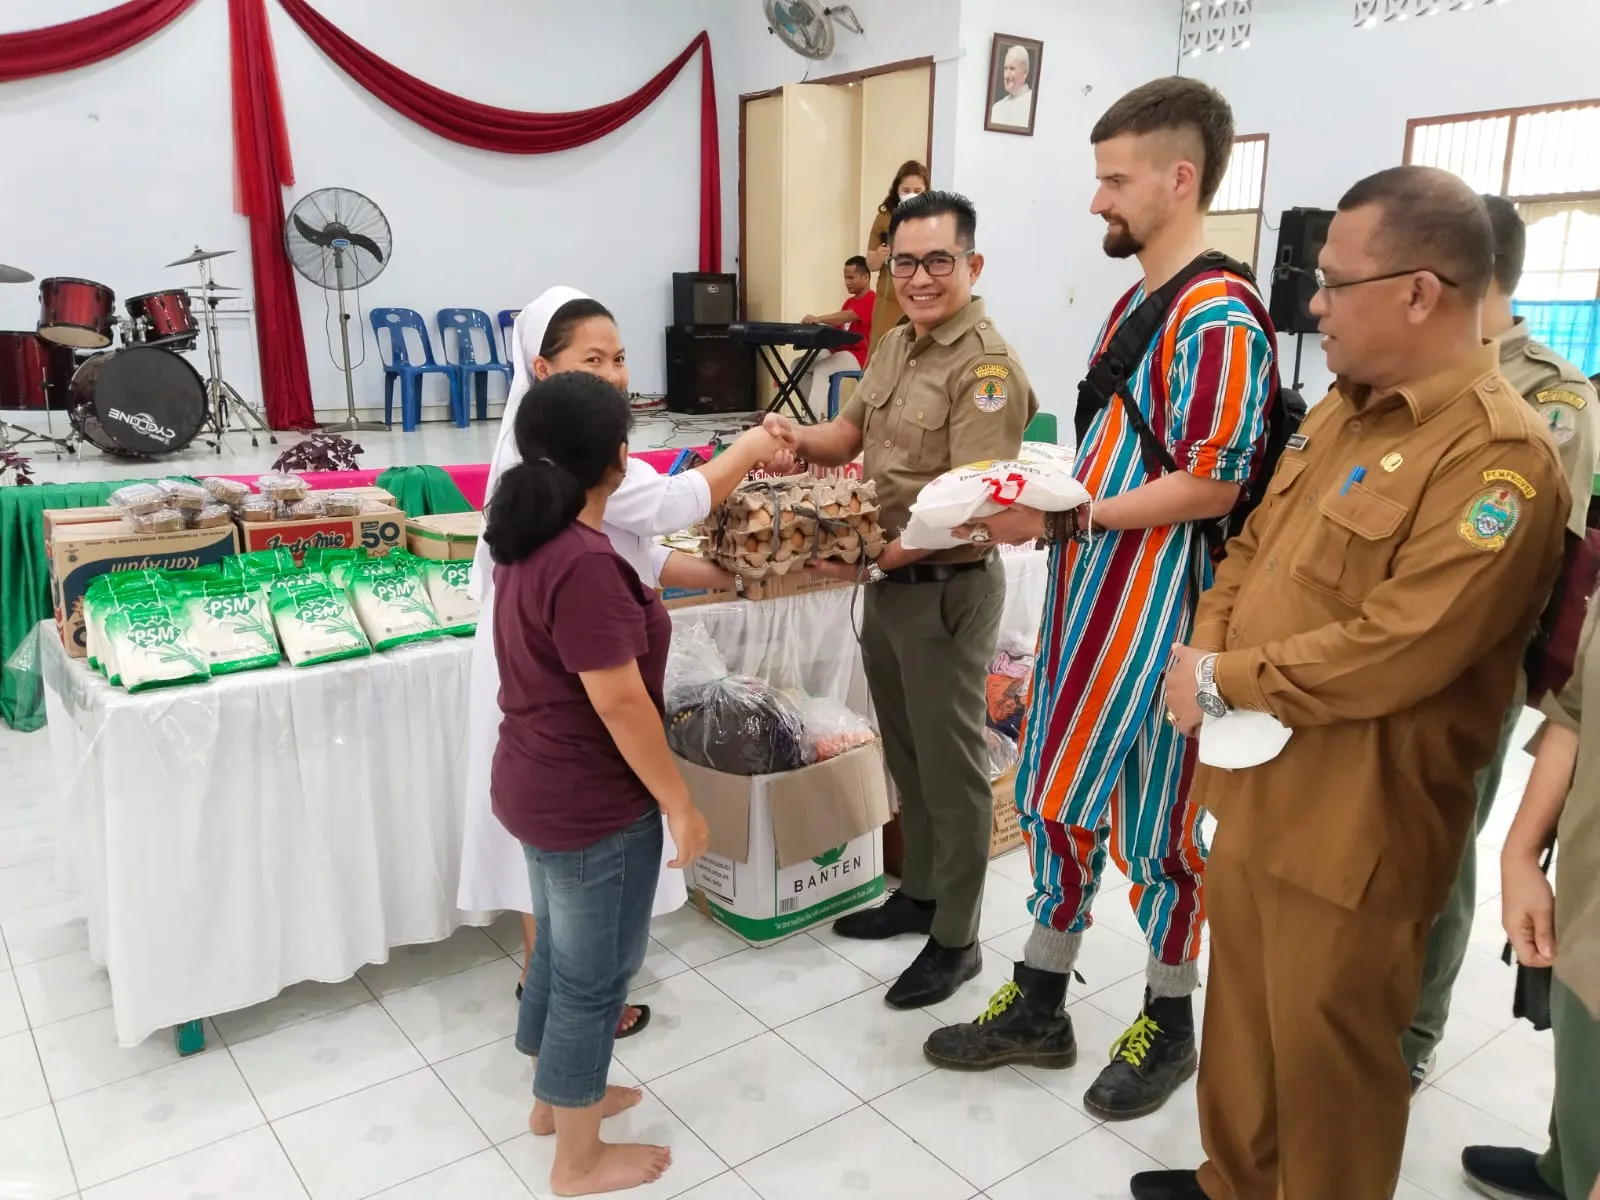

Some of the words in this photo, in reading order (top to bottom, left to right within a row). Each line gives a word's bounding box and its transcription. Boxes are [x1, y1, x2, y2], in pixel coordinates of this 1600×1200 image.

[107, 407, 176, 439] CYCLONE
[267, 531, 345, 554] Idomie
[447, 567, 468, 583] PS
[377, 580, 411, 599] PSM
[211, 597, 250, 616] PSM
[301, 605, 339, 621] PSM
[135, 627, 176, 645] PSM
[794, 856, 862, 893] BANTEN
